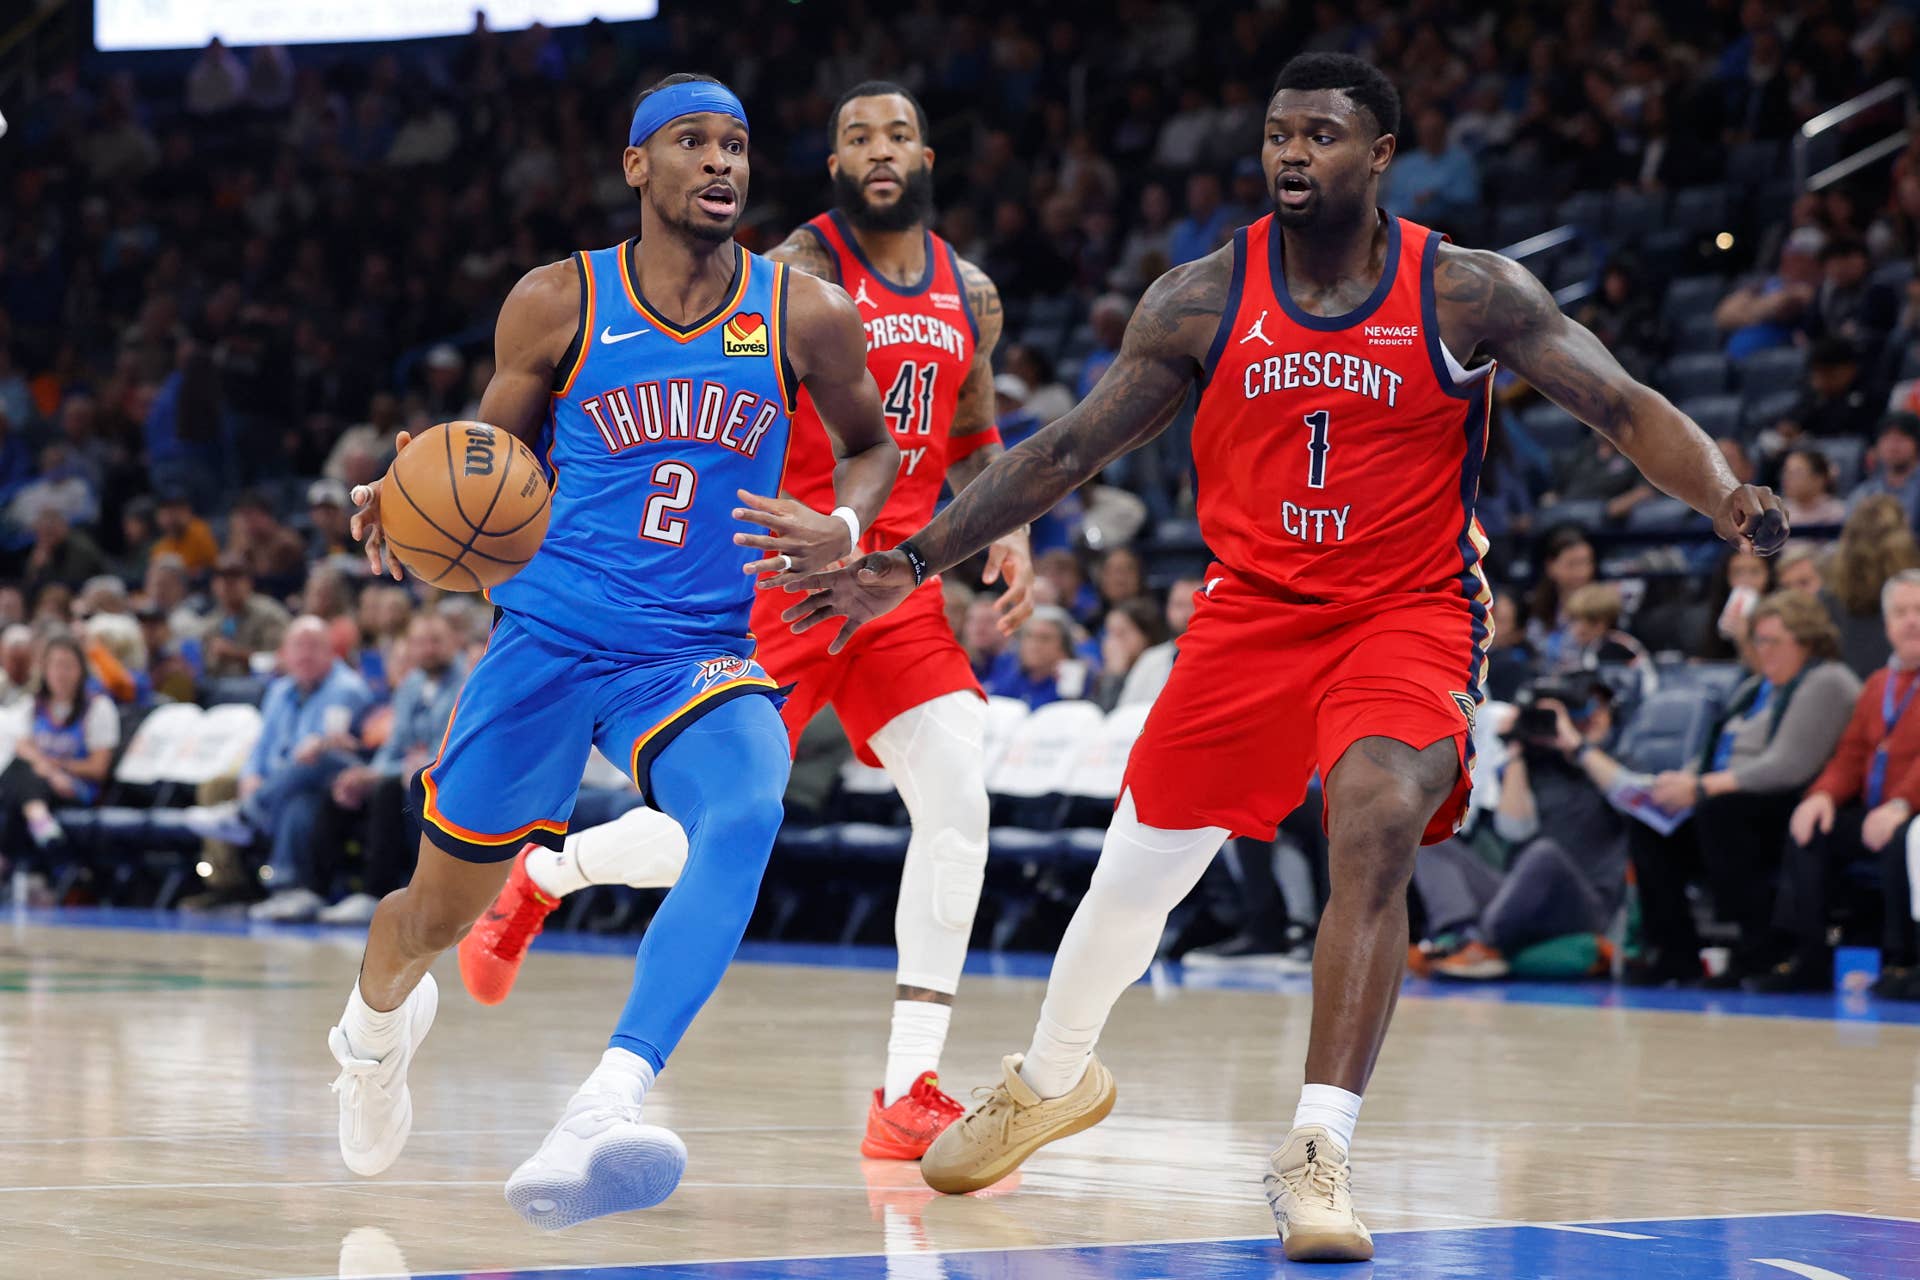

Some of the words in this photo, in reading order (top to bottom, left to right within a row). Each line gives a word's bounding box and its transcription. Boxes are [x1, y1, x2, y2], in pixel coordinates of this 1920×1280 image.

[1364, 326, 1418, 337] NEWAGE
[883, 360, 939, 435] 41
[1244, 351, 1403, 408] CRESCENT
[580, 378, 781, 460] THUNDER
[464, 427, 497, 476] Wil
[899, 446, 928, 476] TY
[1304, 410, 1331, 489] 1
[638, 459, 699, 548] 2
[1281, 501, 1352, 543] CITY
